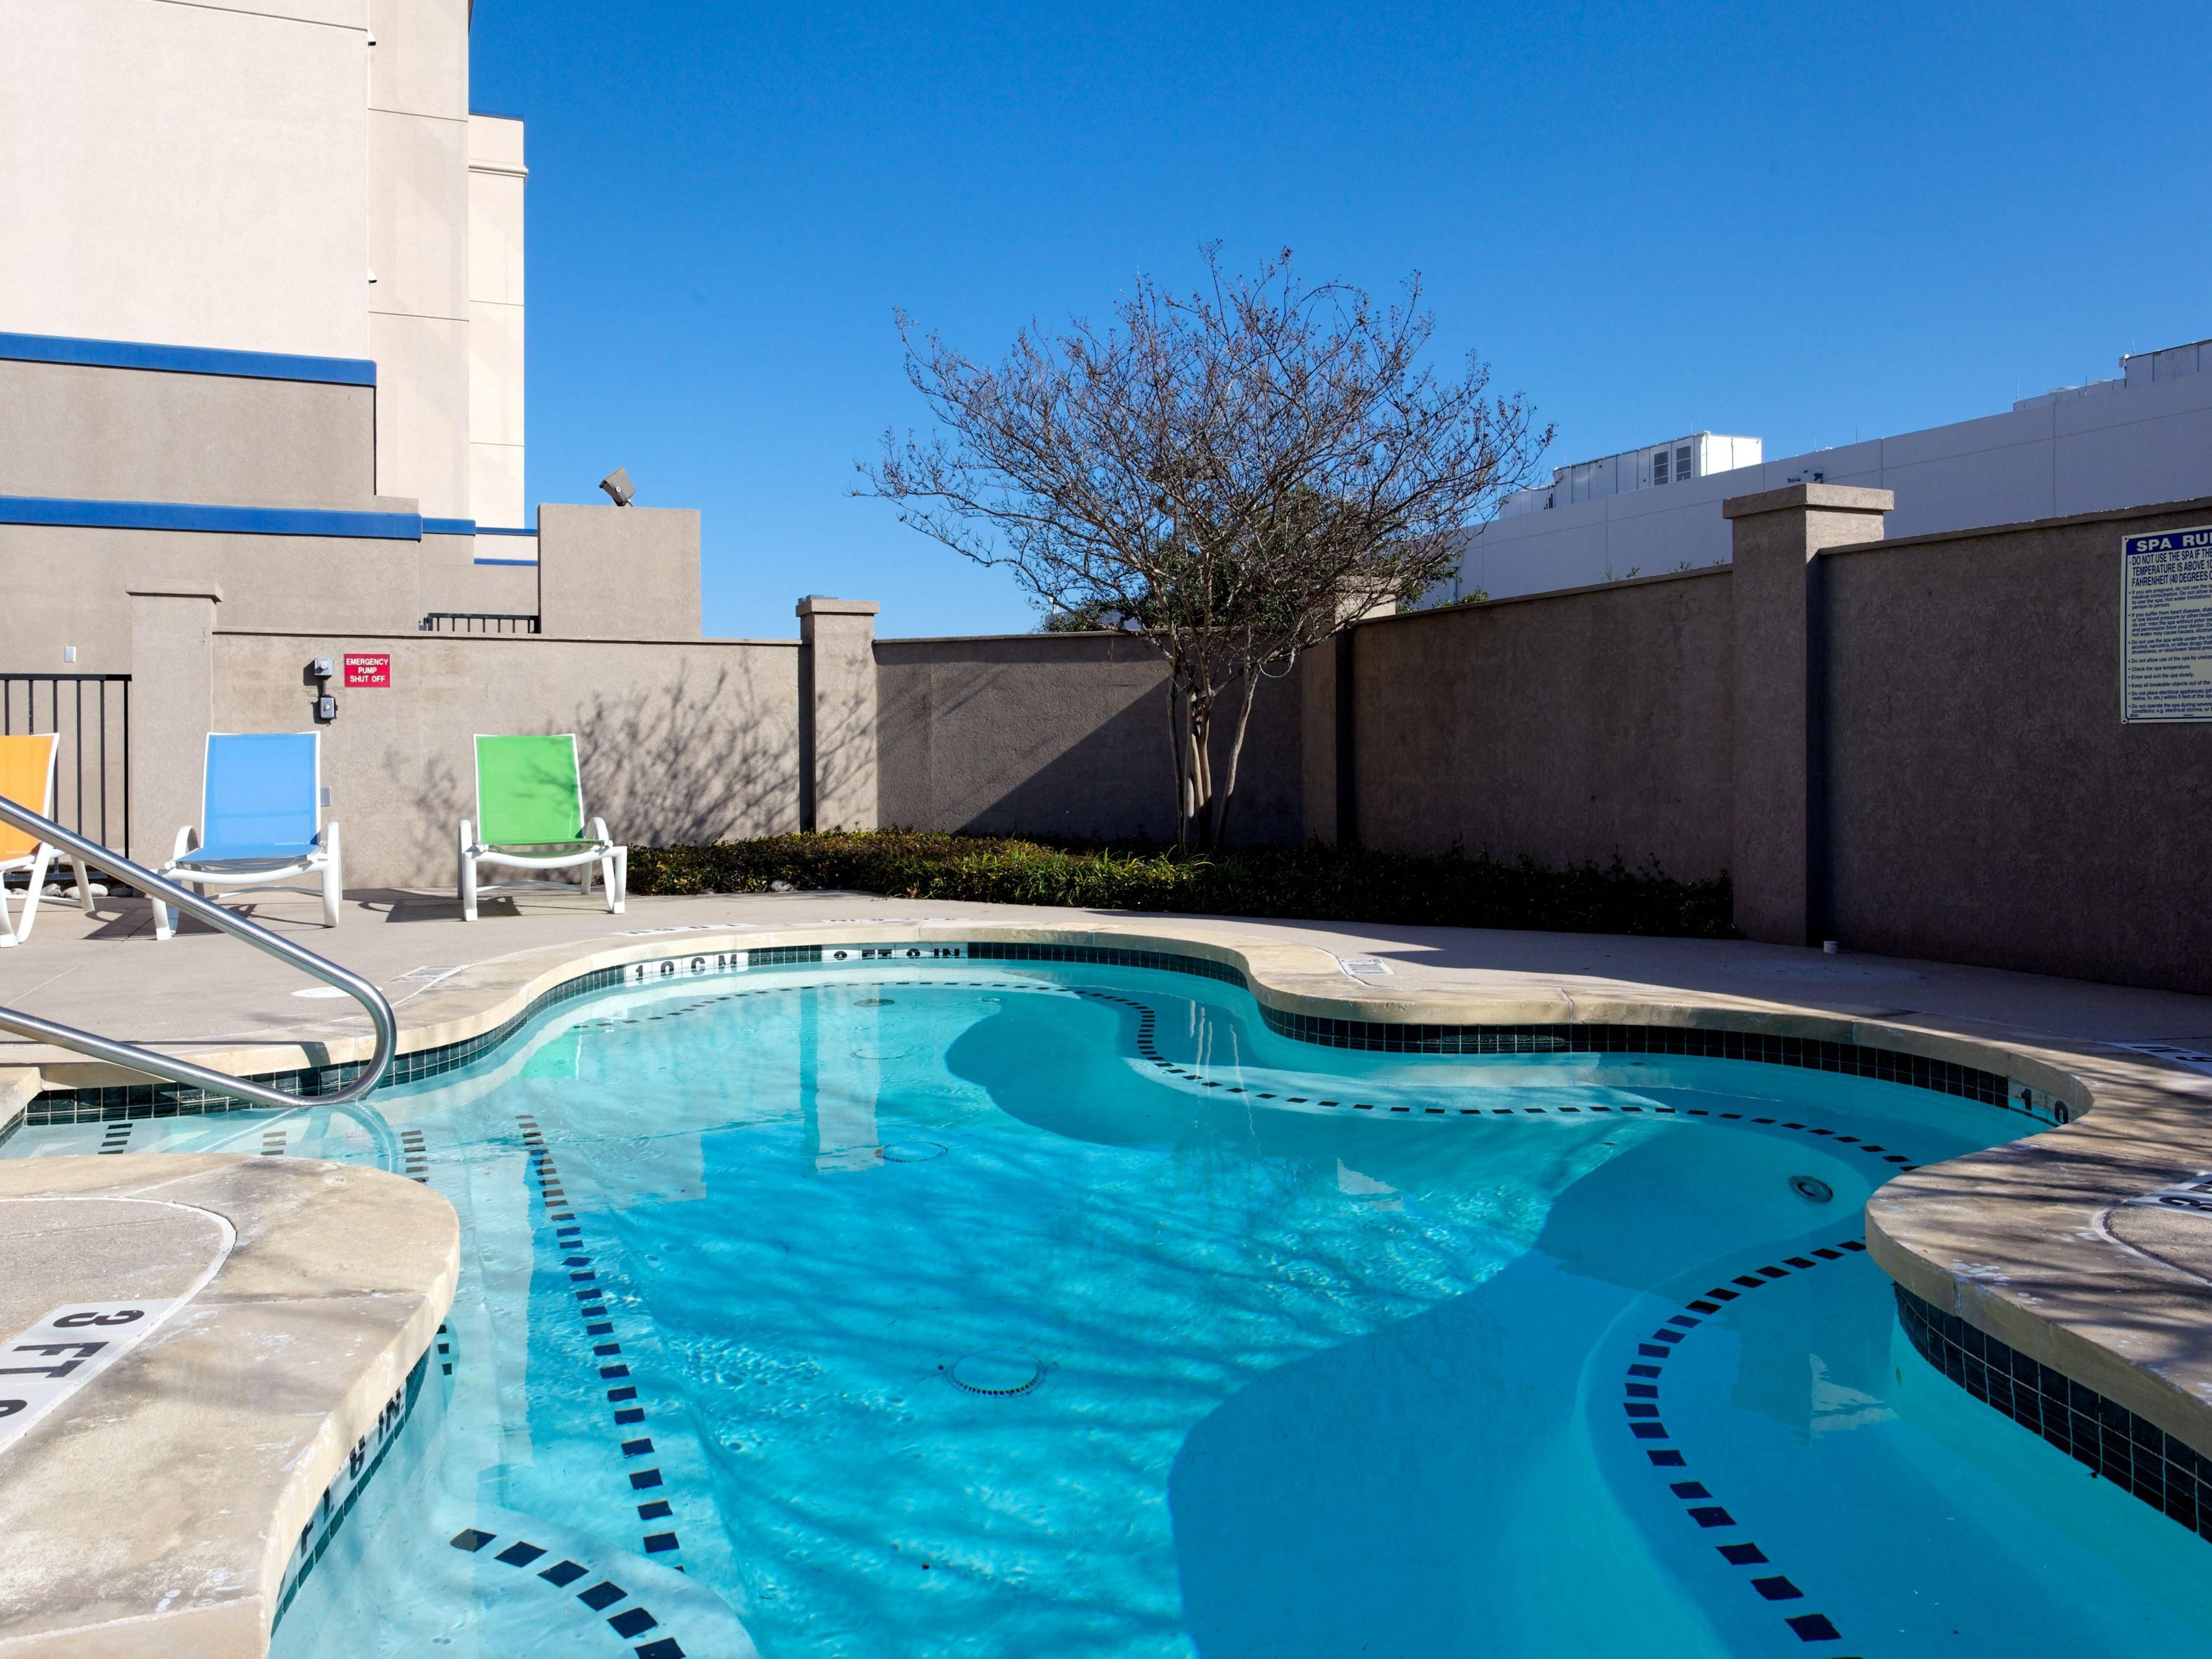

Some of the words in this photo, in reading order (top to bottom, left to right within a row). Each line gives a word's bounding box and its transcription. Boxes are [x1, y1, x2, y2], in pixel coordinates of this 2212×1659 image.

[2137, 538, 2172, 552] SPA
[2183, 533, 2212, 547] RU
[2132, 556, 2140, 565] DO
[2142, 554, 2154, 564] NOT
[2155, 553, 2167, 563] USE
[2168, 552, 2180, 561] THE
[2182, 550, 2193, 560] SPA
[2195, 549, 2200, 558] IF
[2132, 563, 2175, 576] TEMPERATURE
[2177, 563, 2183, 571] IS
[2184, 560, 2205, 571] ABOVE
[2132, 575, 2168, 587] FAHRENHEIT
[2179, 571, 2208, 583] DEGREES
[53, 1310, 144, 1328] 3
